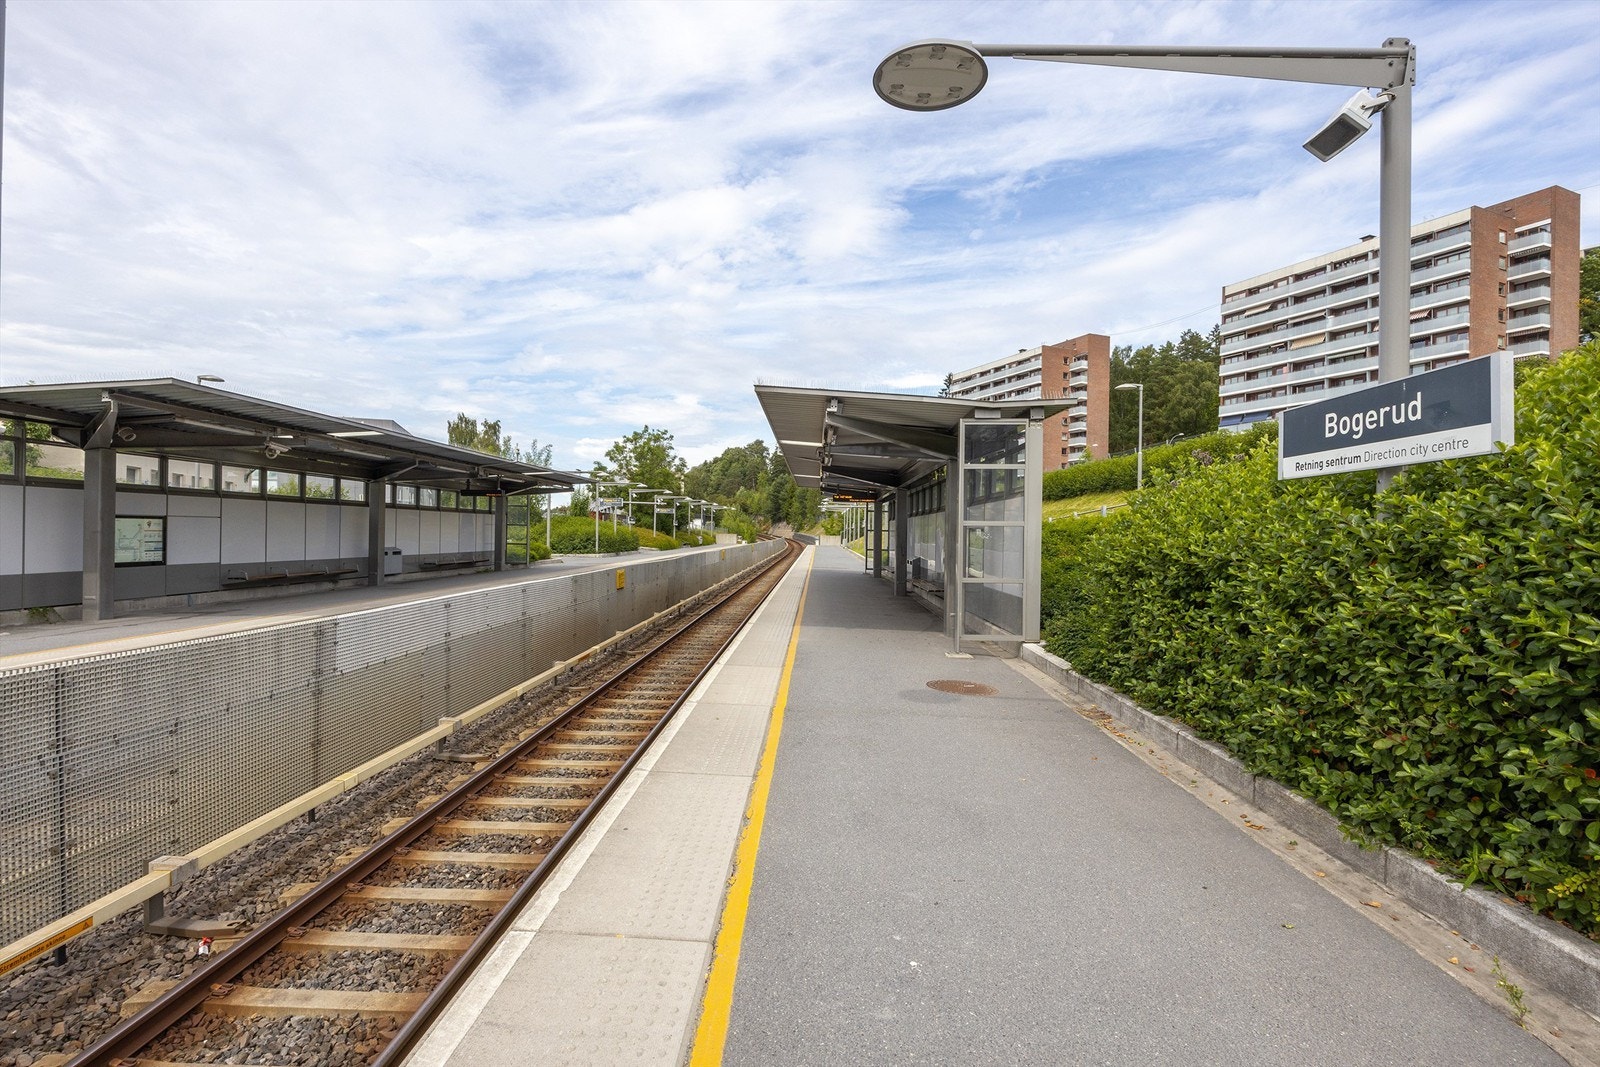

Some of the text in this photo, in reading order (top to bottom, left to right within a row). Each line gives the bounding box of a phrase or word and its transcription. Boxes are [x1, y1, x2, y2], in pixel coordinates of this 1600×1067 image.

[1325, 391, 1422, 439] Bogerud
[1295, 439, 1469, 472] Retning sentrum Direction city centre
